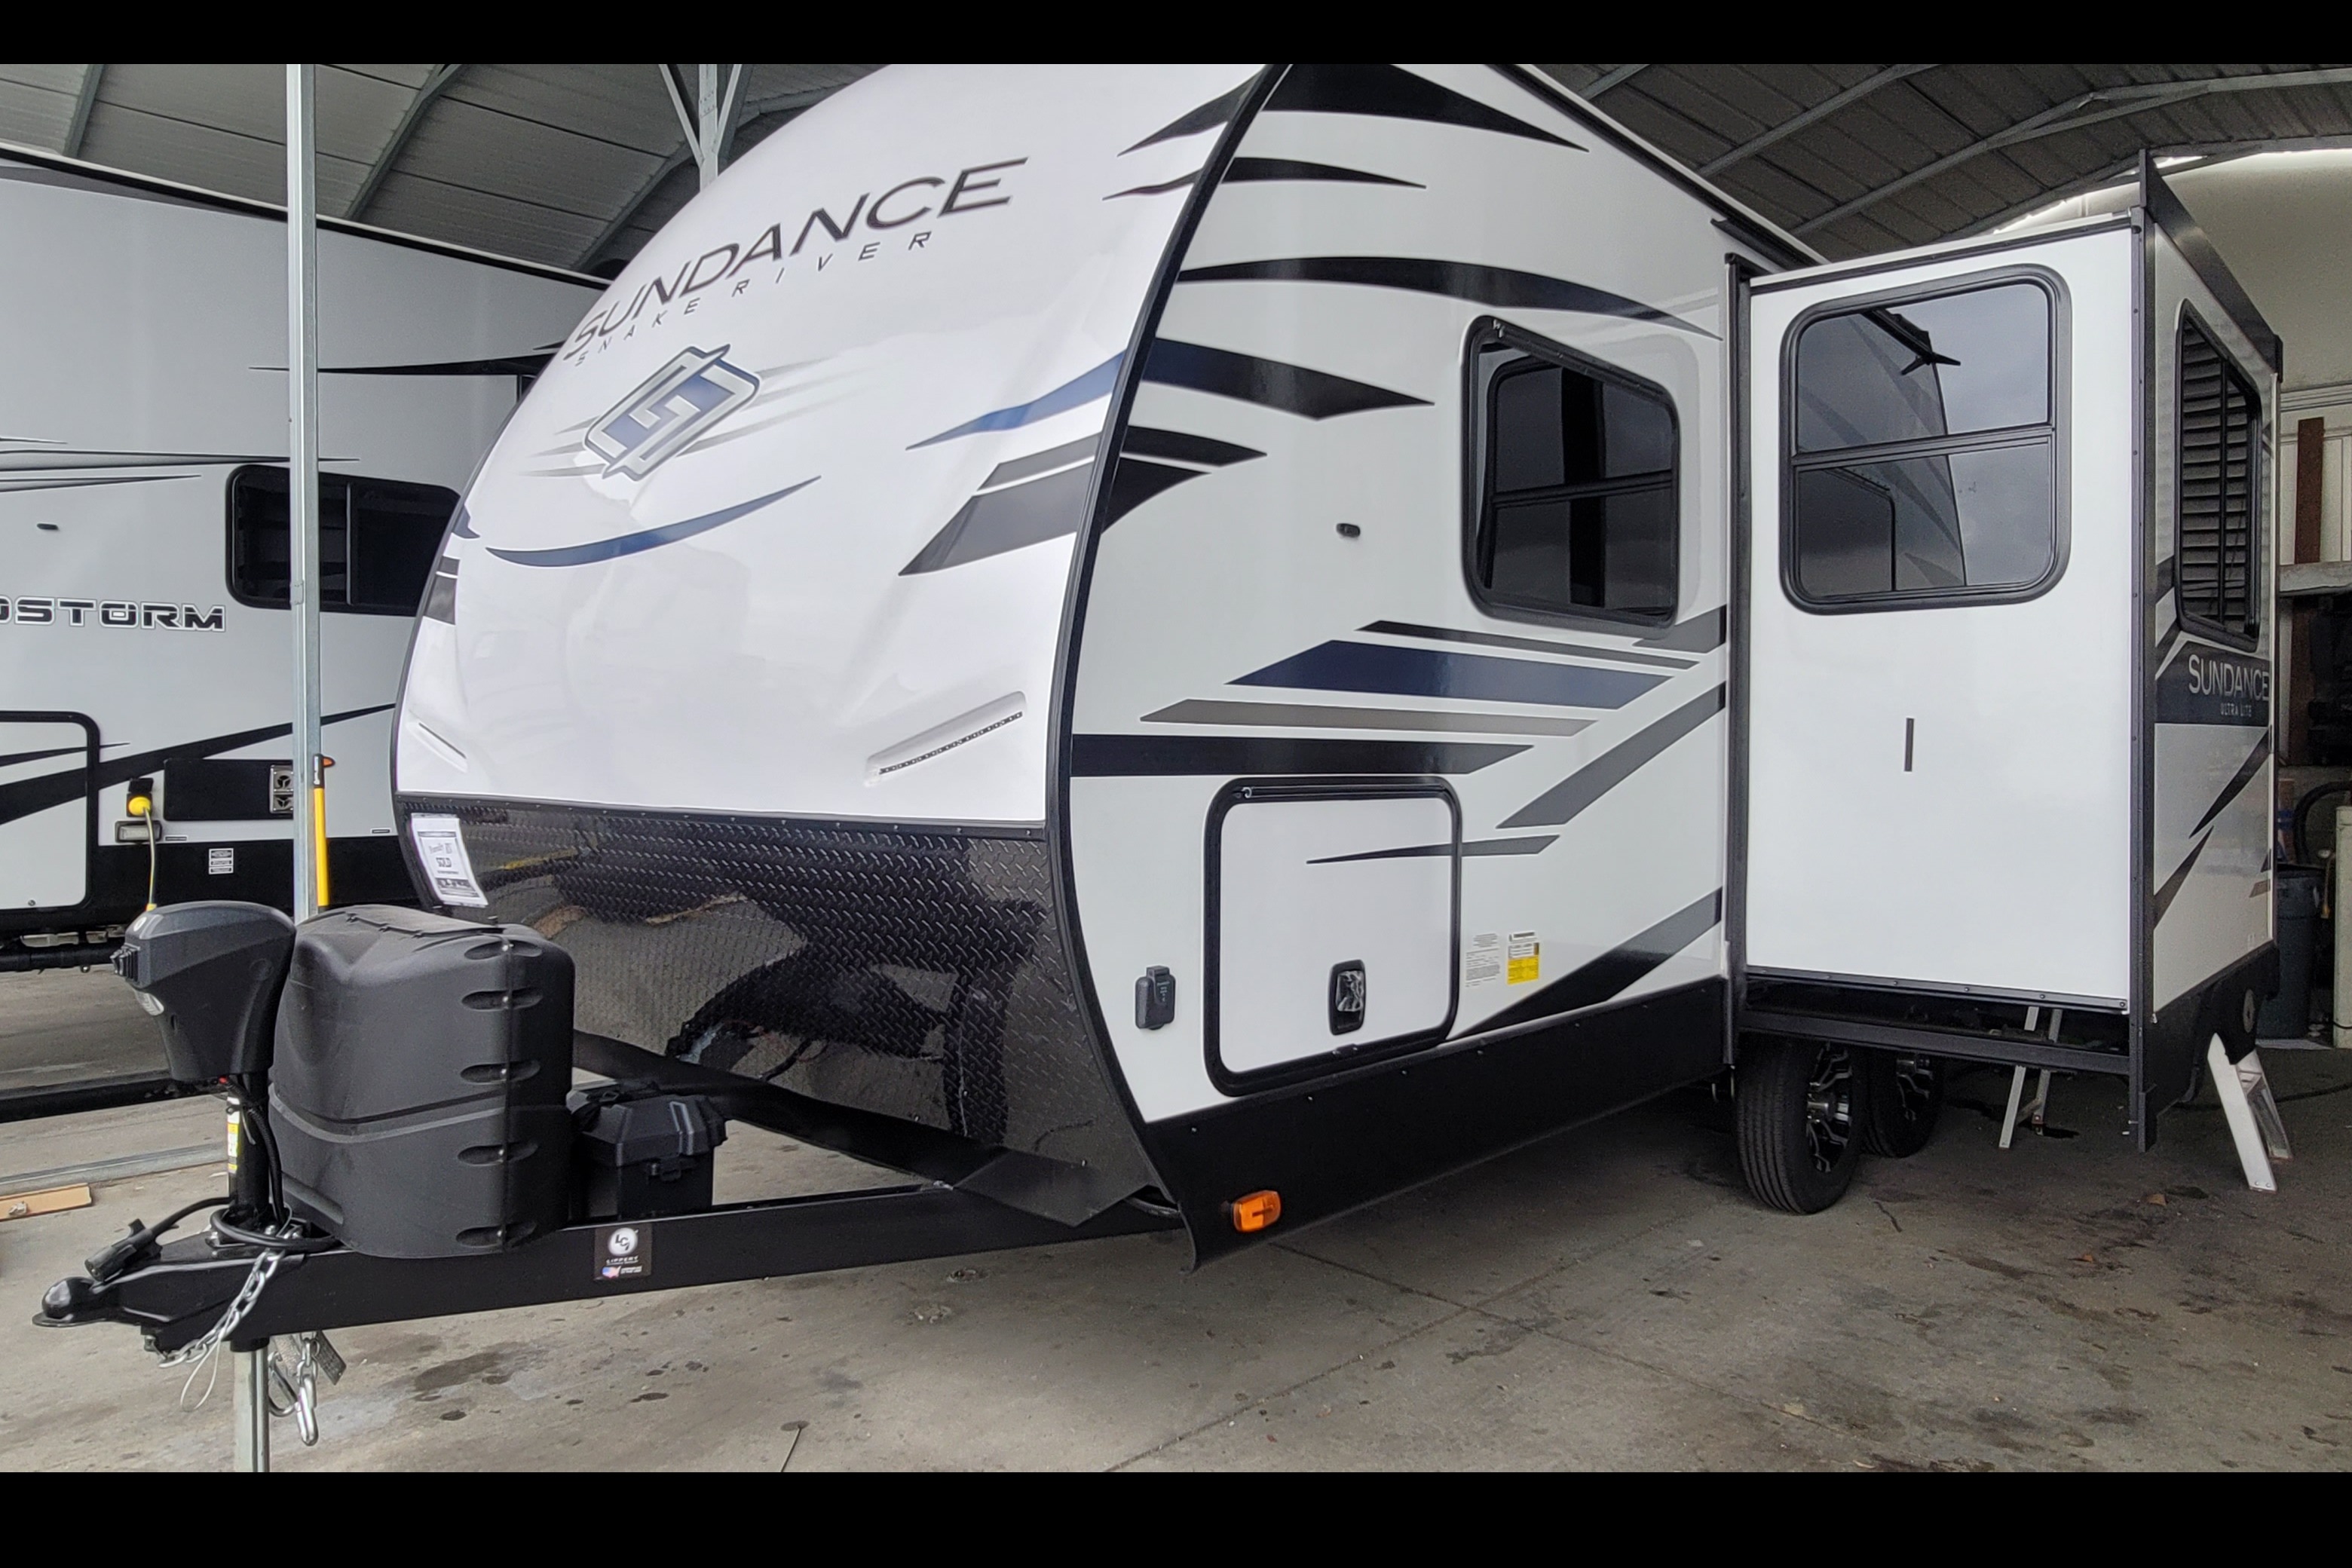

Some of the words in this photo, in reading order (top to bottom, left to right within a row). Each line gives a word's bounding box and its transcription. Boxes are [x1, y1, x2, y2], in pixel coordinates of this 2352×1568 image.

[562, 156, 1029, 360] SUNDANCE
[574, 297, 701, 366] SNAKE
[730, 231, 933, 298] RIVER
[2188, 654, 2270, 701] SUNDANCE
[606, 1255, 639, 1264] LIPPERT
